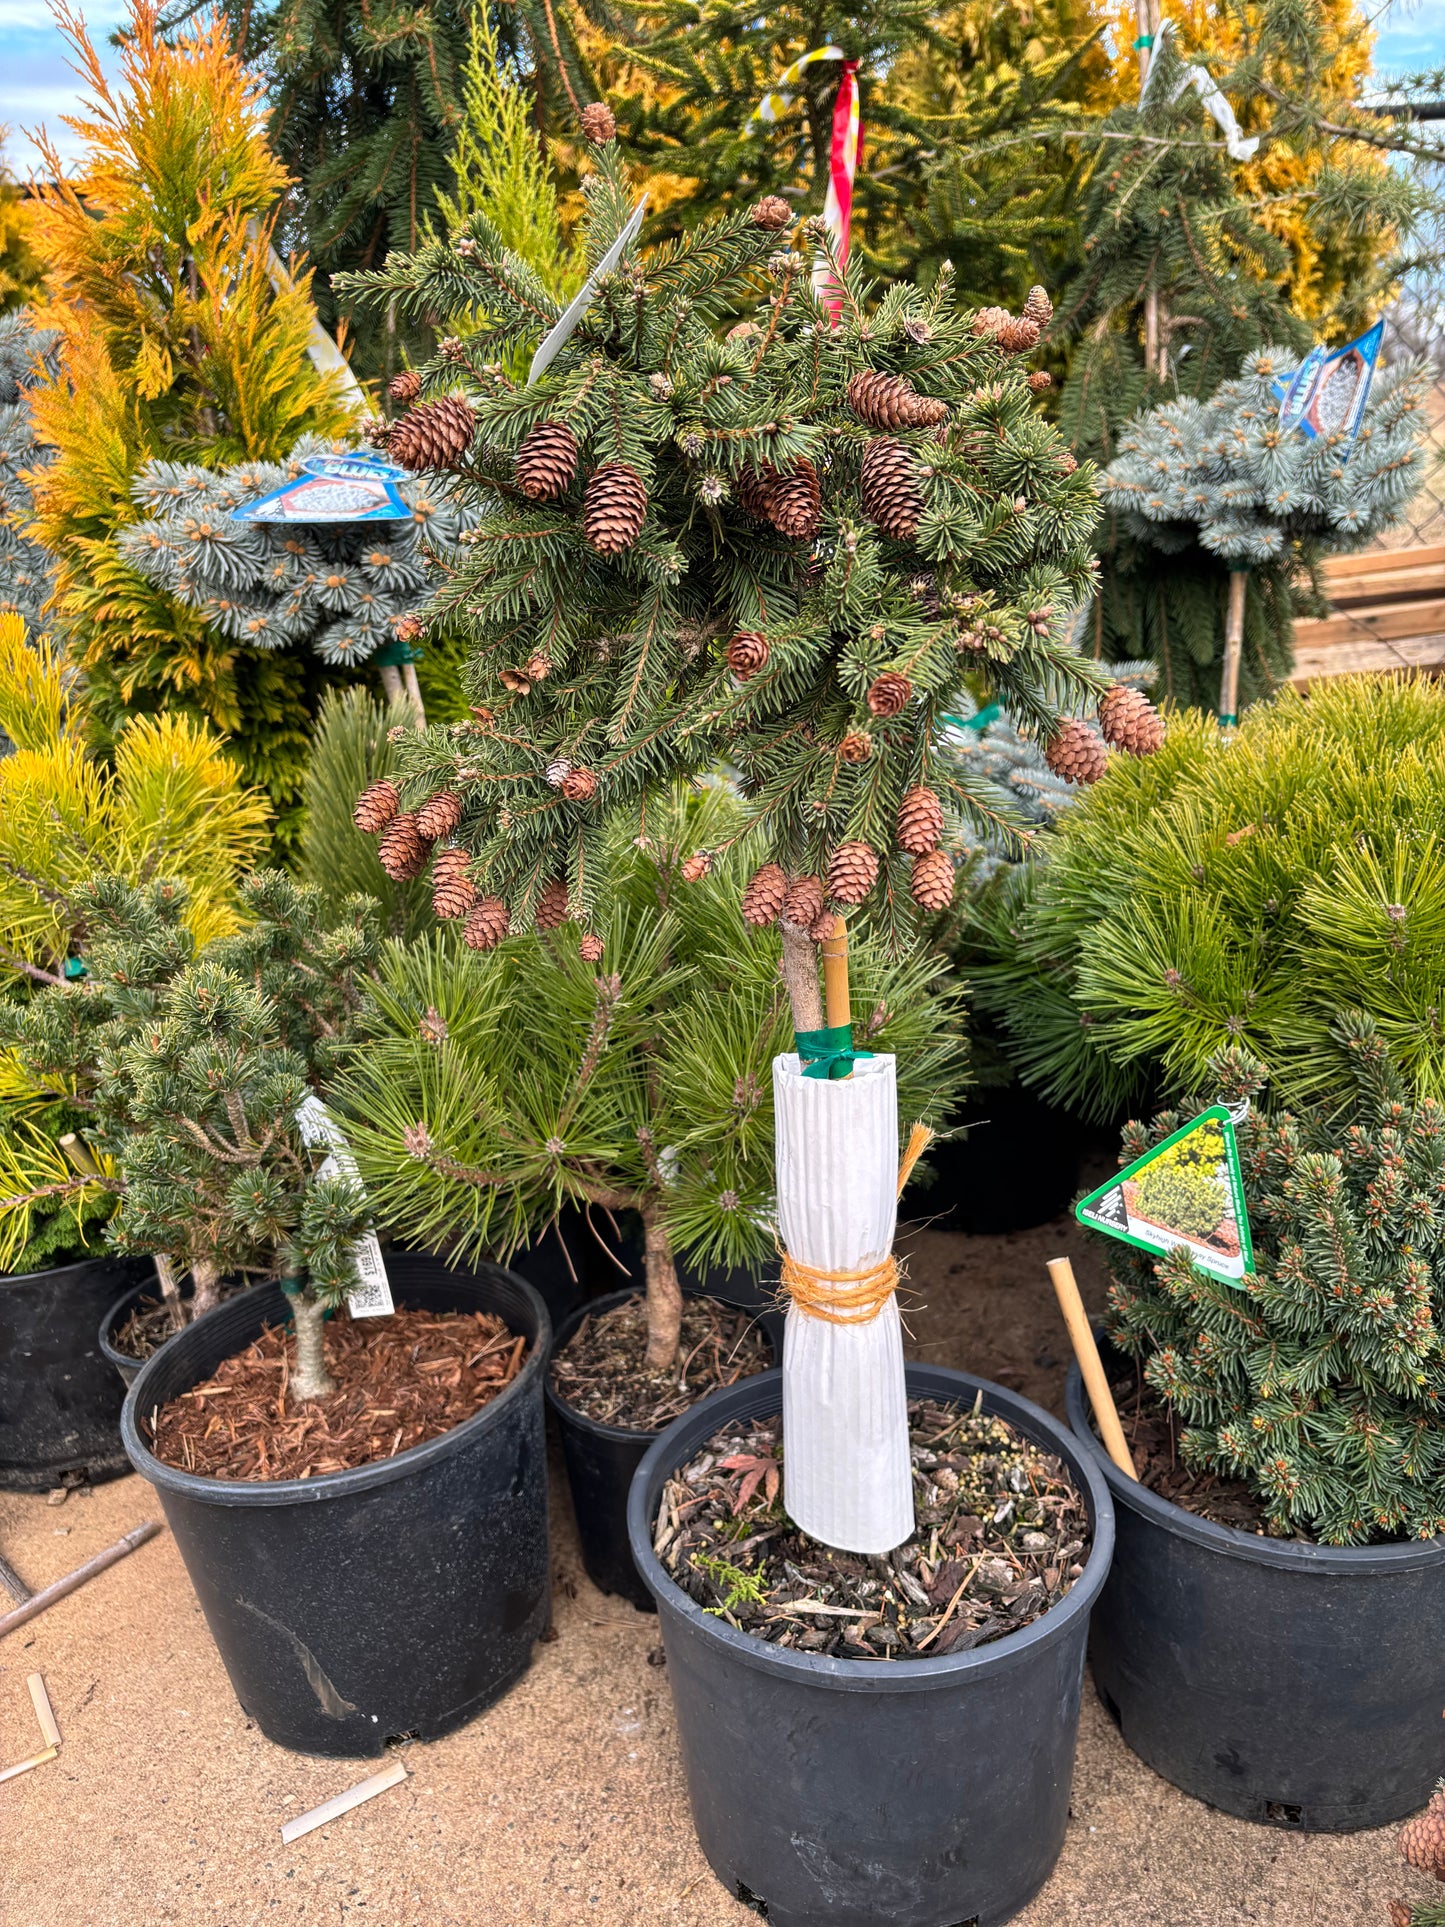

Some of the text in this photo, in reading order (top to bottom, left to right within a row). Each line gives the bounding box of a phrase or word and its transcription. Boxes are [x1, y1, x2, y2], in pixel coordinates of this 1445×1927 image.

[1082, 1208, 1128, 1232] ISELI NURSERY
[1145, 1229, 1170, 1244] Skyhigh
[1206, 1256, 1229, 1269] Spruce
